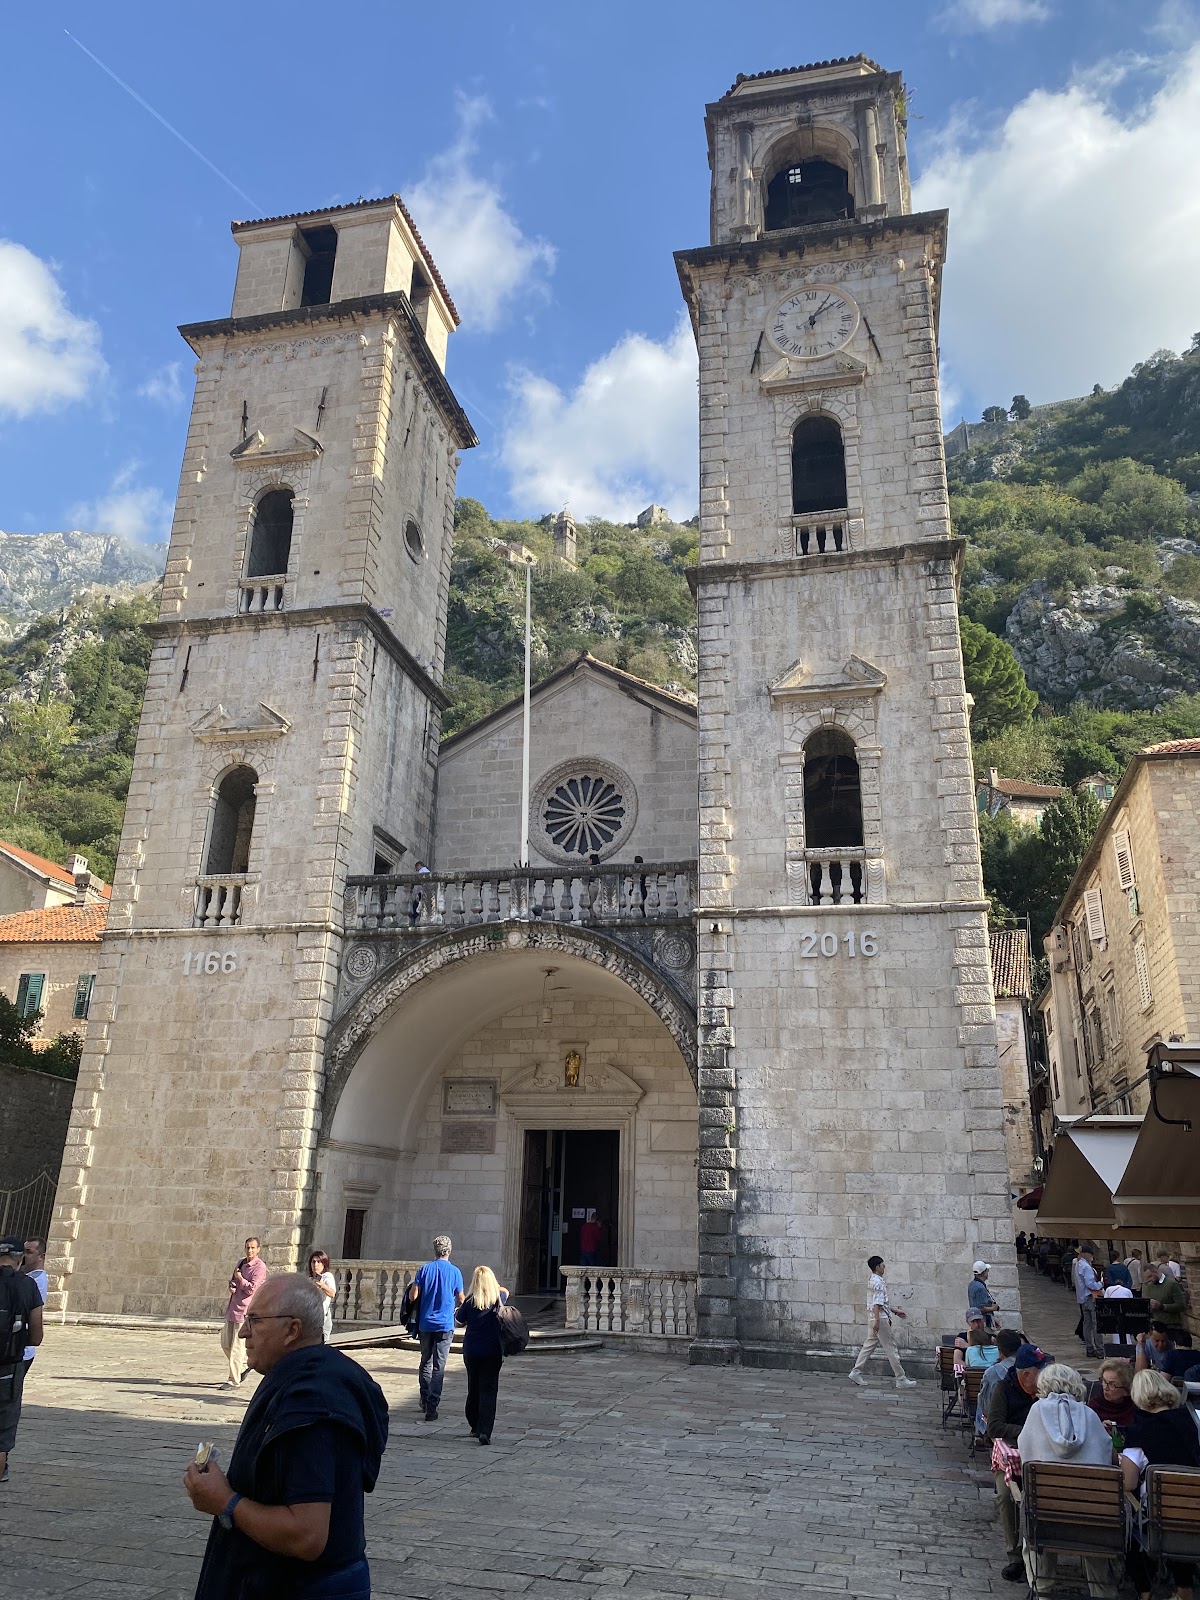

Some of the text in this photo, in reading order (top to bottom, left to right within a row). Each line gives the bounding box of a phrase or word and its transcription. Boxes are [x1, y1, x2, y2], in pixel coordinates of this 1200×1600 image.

[805, 291, 817, 301] XII
[788, 297, 801, 308] XI
[841, 313, 853, 322] III
[773, 323, 784, 333] IX
[789, 343, 802, 355] VII
[809, 346, 819, 355] VI
[800, 930, 879, 958] 2016
[181, 950, 238, 976] 1166
